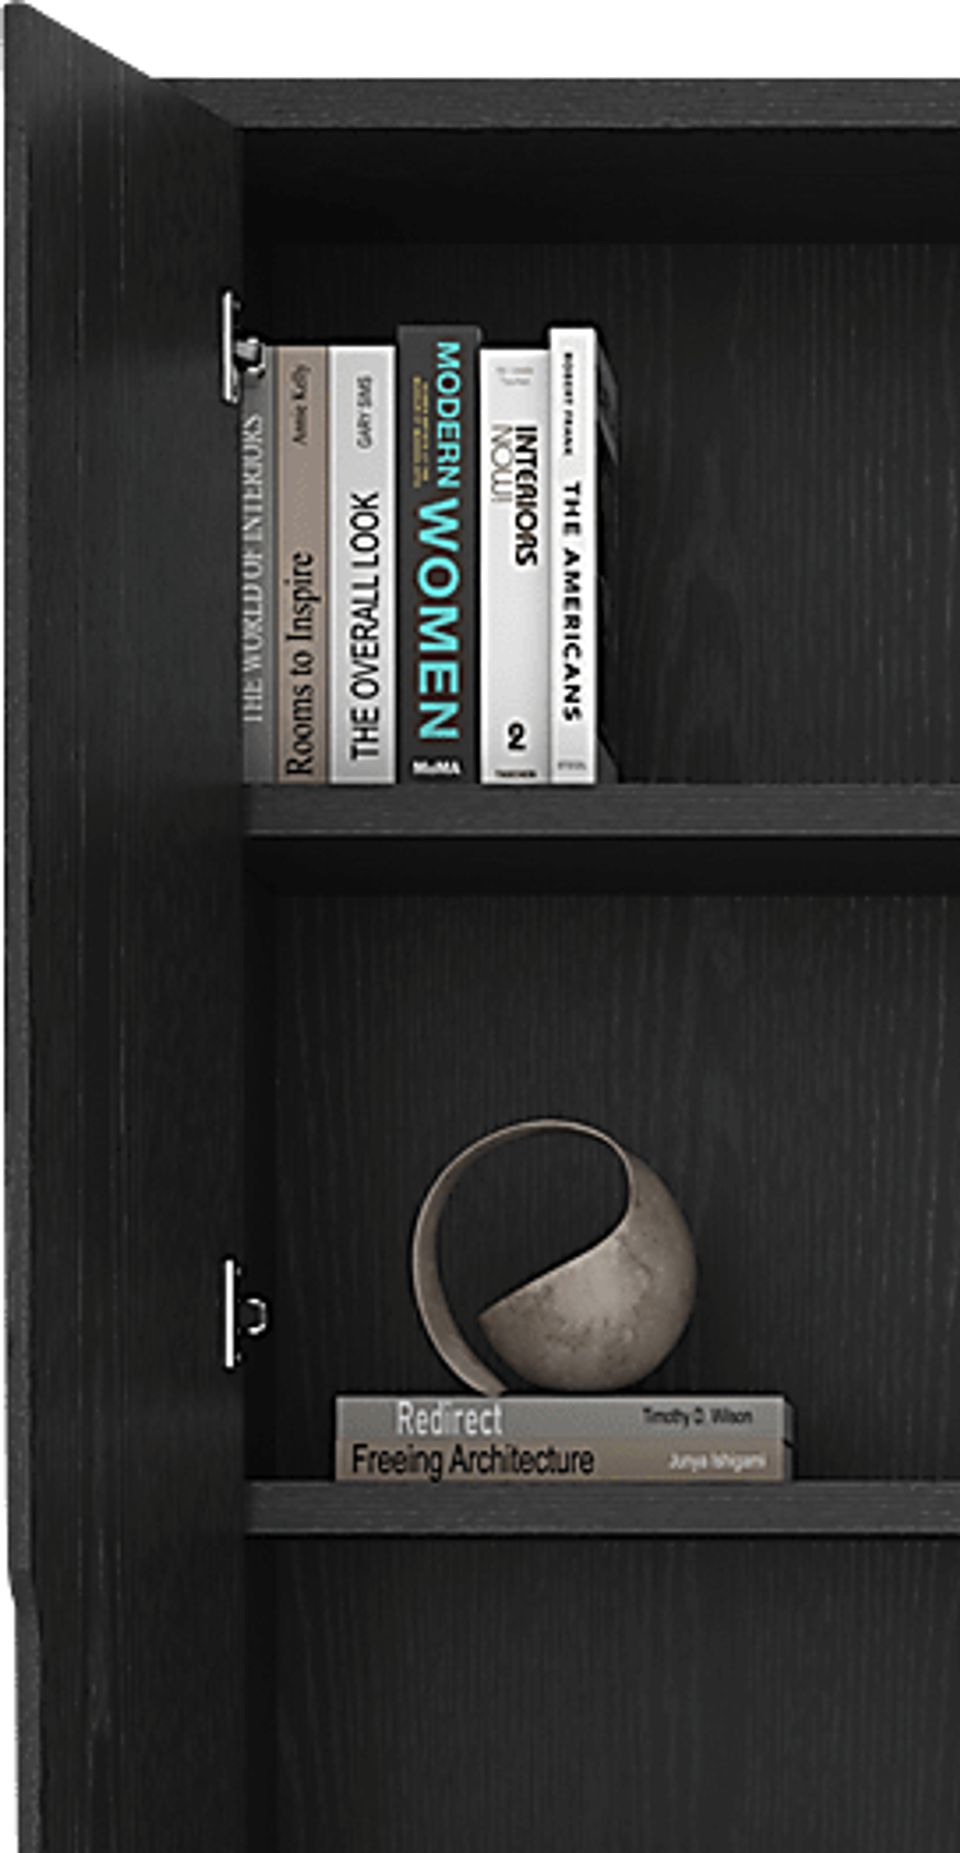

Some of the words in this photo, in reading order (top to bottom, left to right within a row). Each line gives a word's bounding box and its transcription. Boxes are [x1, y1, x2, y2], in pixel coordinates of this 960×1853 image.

[564, 352, 573, 405] ROBERT
[436, 341, 462, 488] MODERN
[564, 410, 573, 455] FRANK
[515, 426, 538, 566] INTERIORS
[564, 481, 581, 535] THE
[350, 492, 379, 567] LOOK
[283, 552, 322, 641] Inspire
[418, 498, 460, 739] WOMEN
[350, 574, 379, 700] OVERALL
[563, 547, 582, 721] AMERICANS
[290, 651, 314, 675] to
[286, 684, 314, 775] Rooms
[351, 707, 379, 760] THE
[507, 721, 526, 750] 2
[397, 1400, 503, 1436] Redirect
[642, 1407, 690, 1427] Timothy
[710, 1407, 753, 1425] Wilson
[352, 1443, 443, 1483] Freeing
[448, 1443, 595, 1475] Architecture
